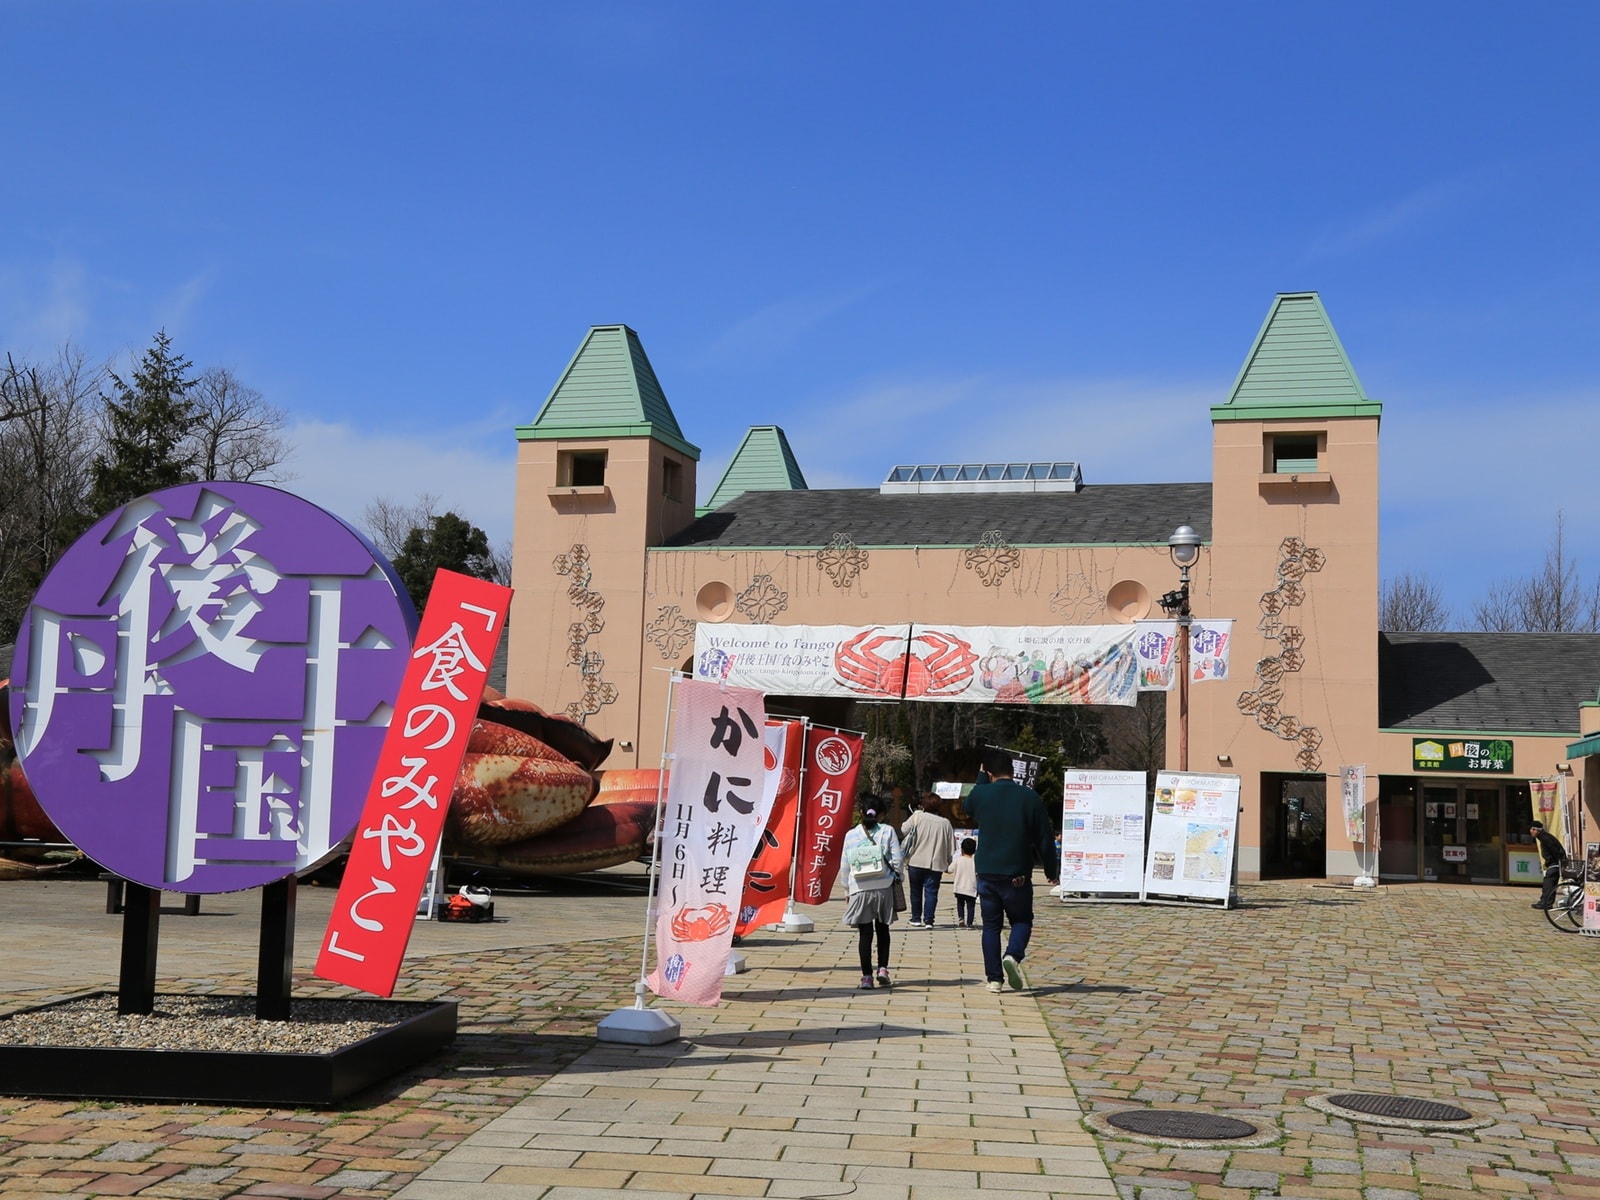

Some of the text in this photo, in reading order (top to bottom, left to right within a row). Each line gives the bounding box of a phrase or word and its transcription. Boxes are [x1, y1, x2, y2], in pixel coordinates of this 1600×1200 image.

[709, 636, 835, 652] Welcome to Tango
[327, 602, 497, 962] 「食のみやこ」
[700, 705, 759, 895] かに料理
[1468, 759, 1504, 770] お野菜
[807, 778, 843, 898] 旬の京丹後
